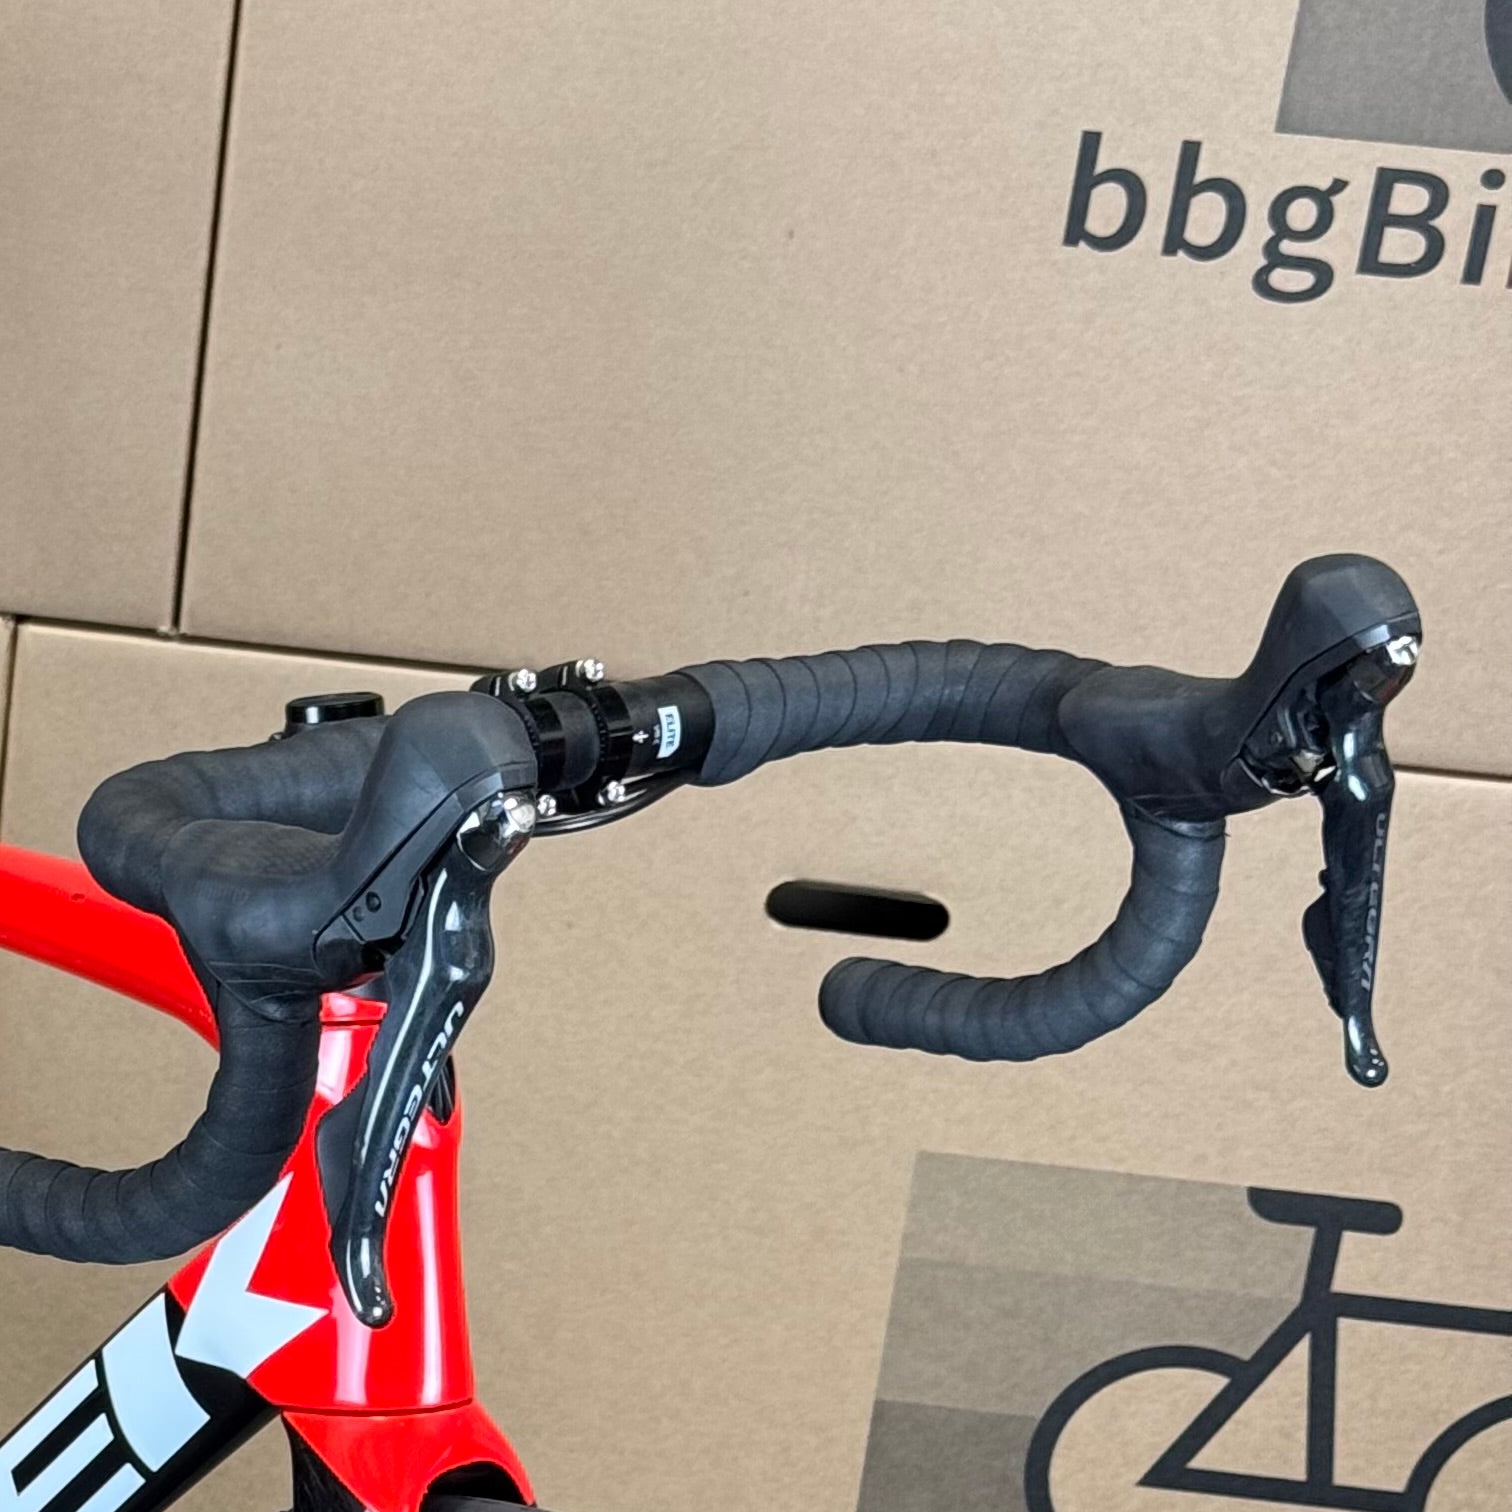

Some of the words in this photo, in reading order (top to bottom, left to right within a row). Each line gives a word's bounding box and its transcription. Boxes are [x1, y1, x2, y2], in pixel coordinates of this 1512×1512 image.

[1062, 129, 1512, 304] bbgBi
[665, 713, 676, 748] ELITE
[374, 1000, 464, 1217] ULTEGRA
